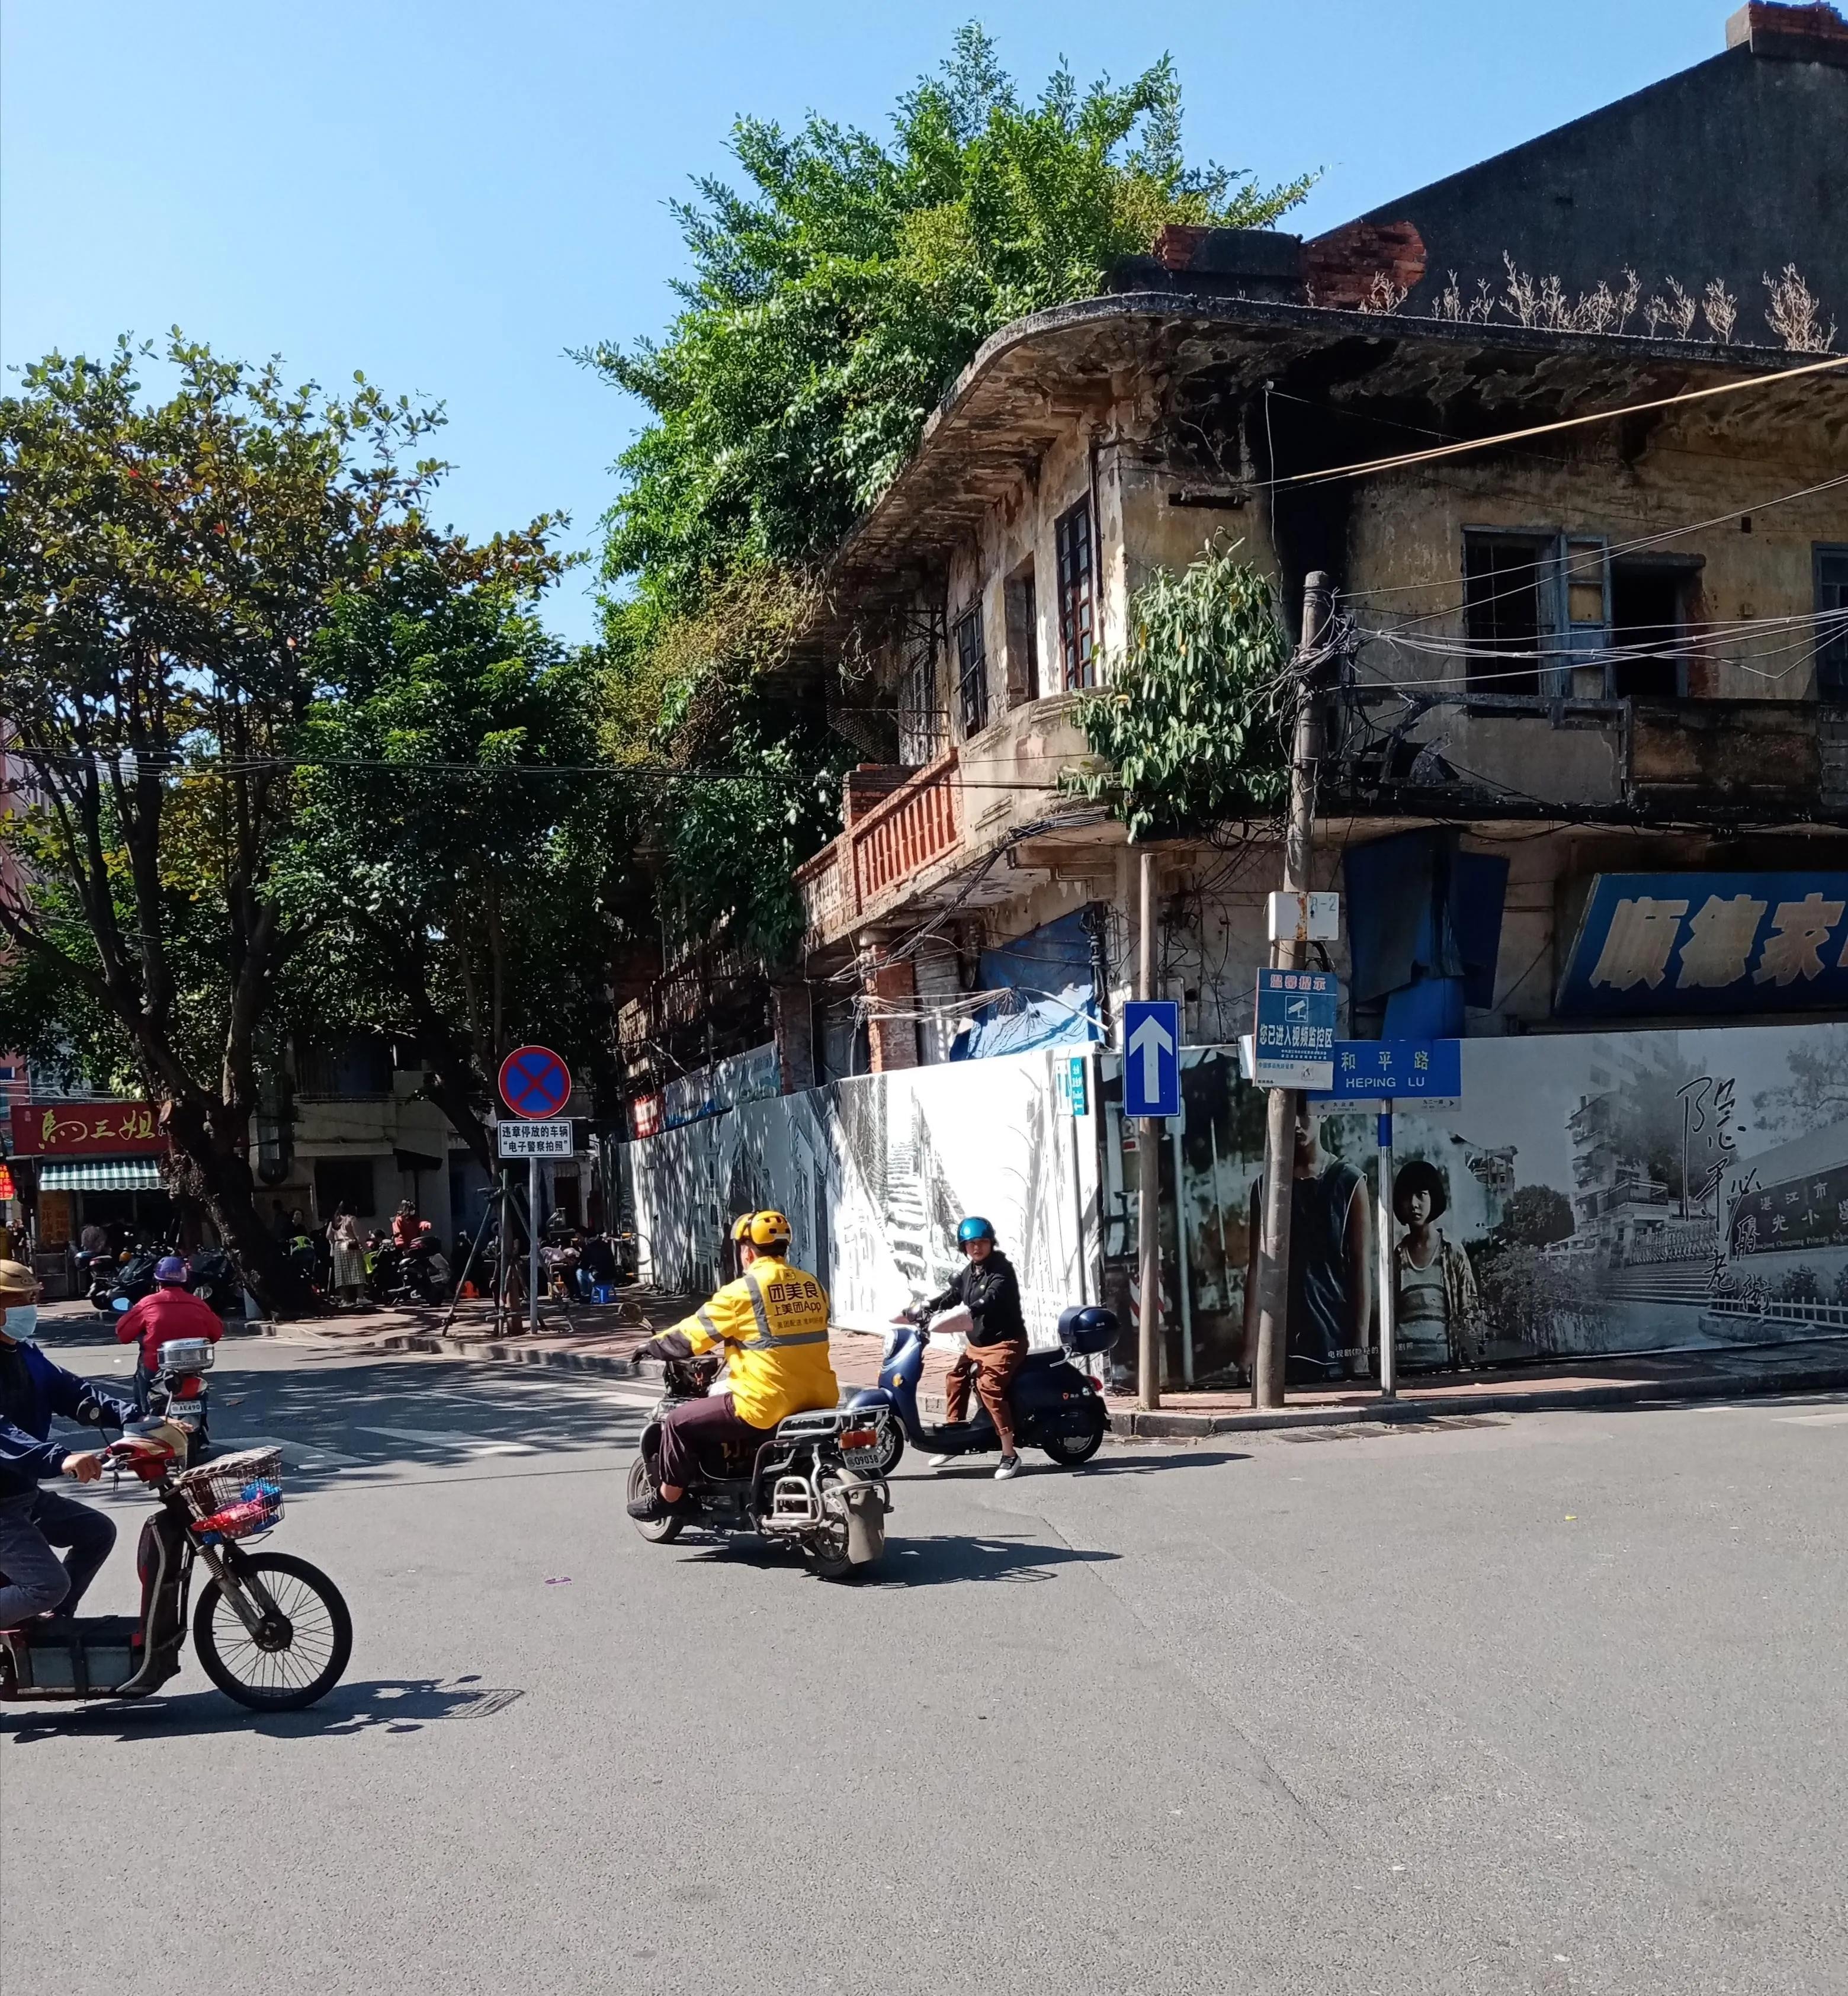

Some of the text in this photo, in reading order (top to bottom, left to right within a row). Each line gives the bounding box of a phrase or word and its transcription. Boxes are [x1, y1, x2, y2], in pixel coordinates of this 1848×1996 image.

[1589, 893, 1848, 991] 顺德家
[1269, 974, 1326, 991] 温馨提示
[1259, 1023, 1333, 1048] 您已进入视频监控区
[1341, 1050, 1429, 1071] 和平路
[1345, 1077, 1424, 1088] HEPING LU
[502, 1125, 569, 1138] 违章停放的车辆
[767, 1281, 819, 1303] 团美食
[774, 1300, 822, 1316] 上美团App
